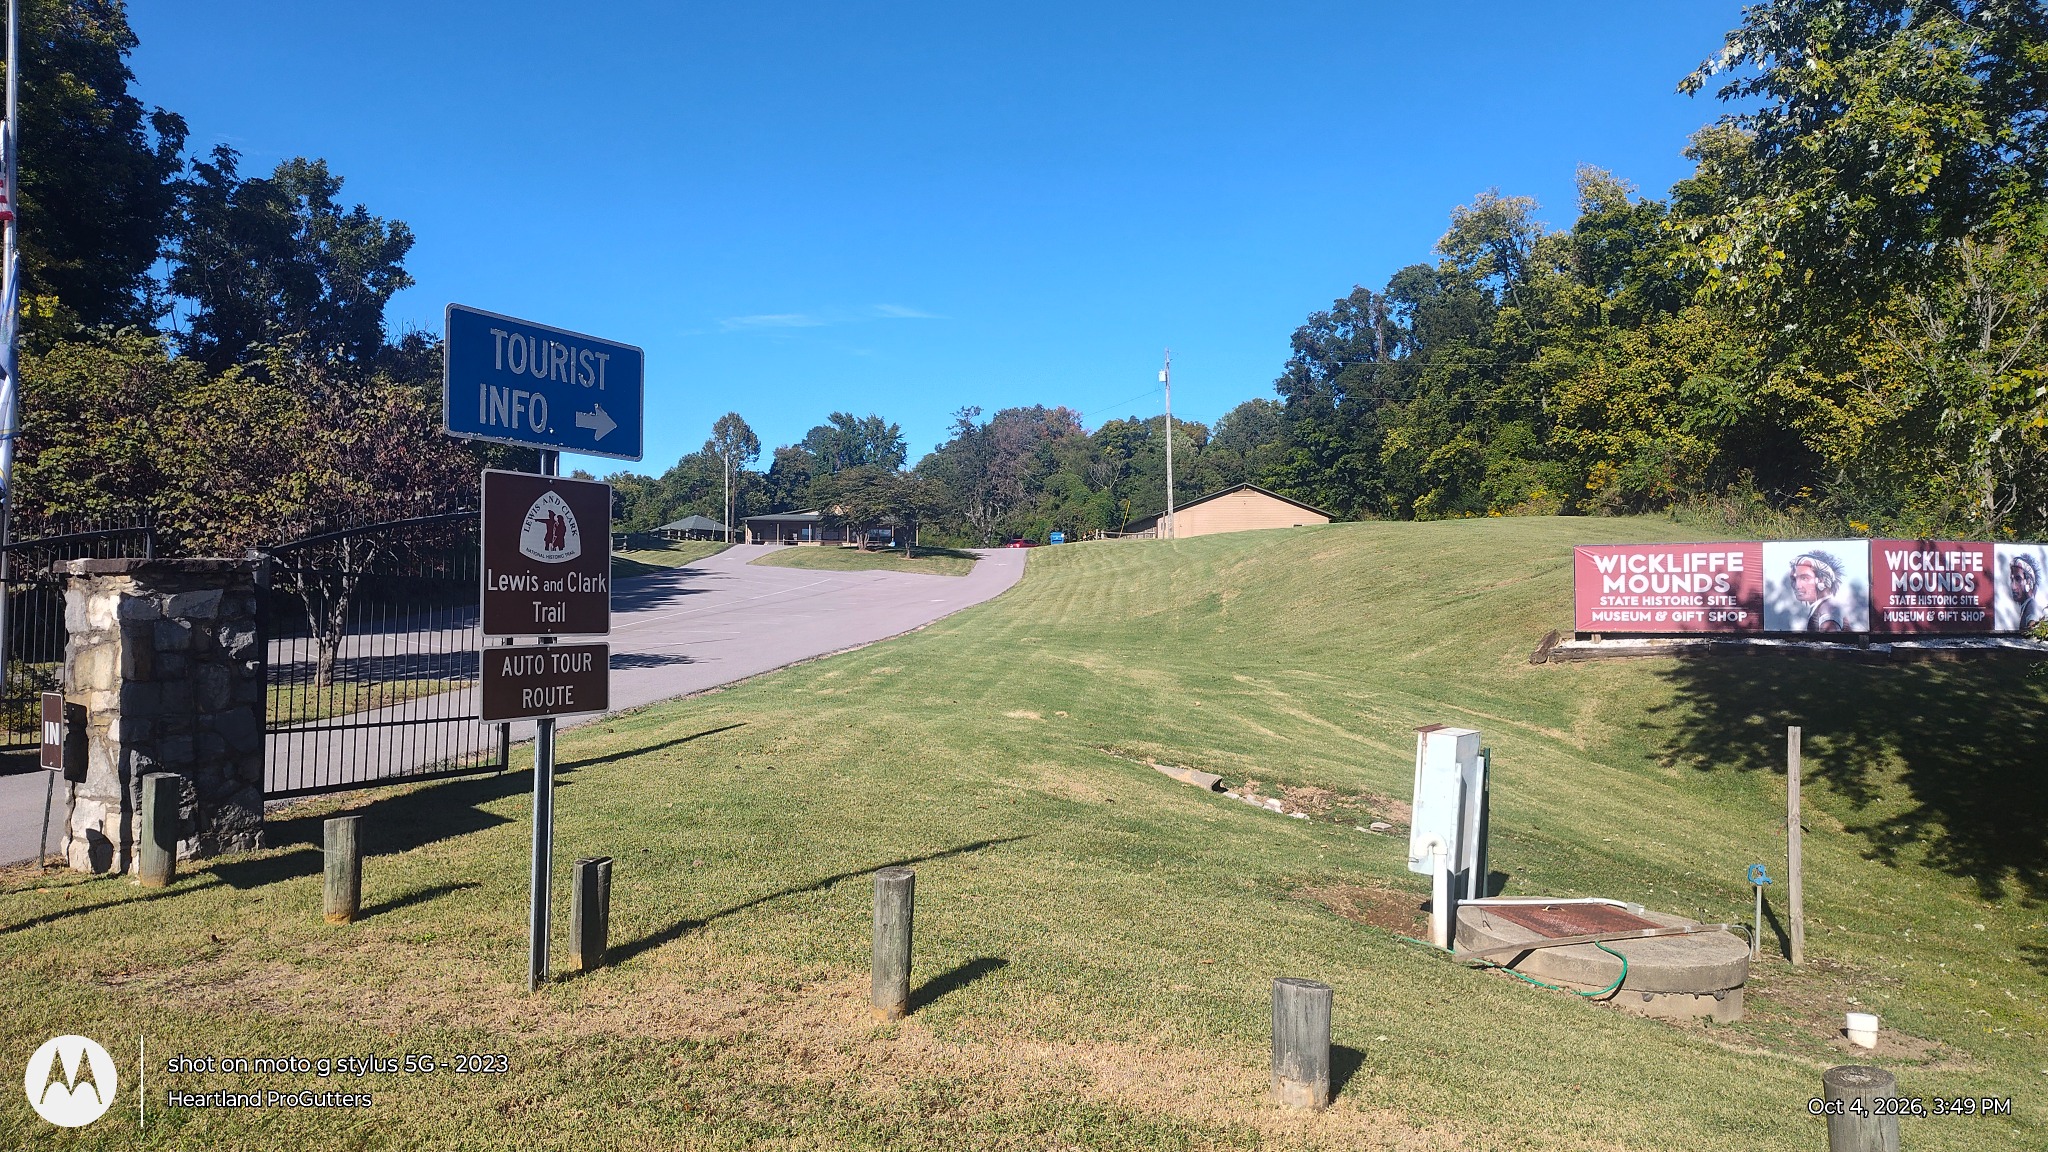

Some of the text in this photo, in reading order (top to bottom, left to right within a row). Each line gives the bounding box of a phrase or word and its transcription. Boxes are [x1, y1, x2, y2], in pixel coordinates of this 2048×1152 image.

[490, 328, 610, 390] TOURIST
[479, 383, 548, 433] INFO
[524, 495, 578, 537] LEWIS AND CLARK
[526, 547, 545, 559] NATIONAL
[1593, 552, 1744, 574] WICKLIFFE
[1885, 550, 1984, 572] WICKLIFFE
[487, 568, 607, 593] Lewis and Clark
[1603, 573, 1731, 594] MOUNDS
[1891, 572, 1975, 593] MOUNDS
[1599, 595, 1737, 606] STATE HISTORIC SITE
[1889, 594, 1979, 606] STATE HISTORIC SITE
[532, 601, 566, 623] Trail
[1592, 611, 1748, 622] MUSEUM & GIFT SHOP
[1883, 611, 1986, 622] MUSEUM & GIFT SHOP
[501, 652, 592, 677] AUTO TOUR
[522, 685, 574, 709] ROUTE
[44, 721, 60, 746] IN
